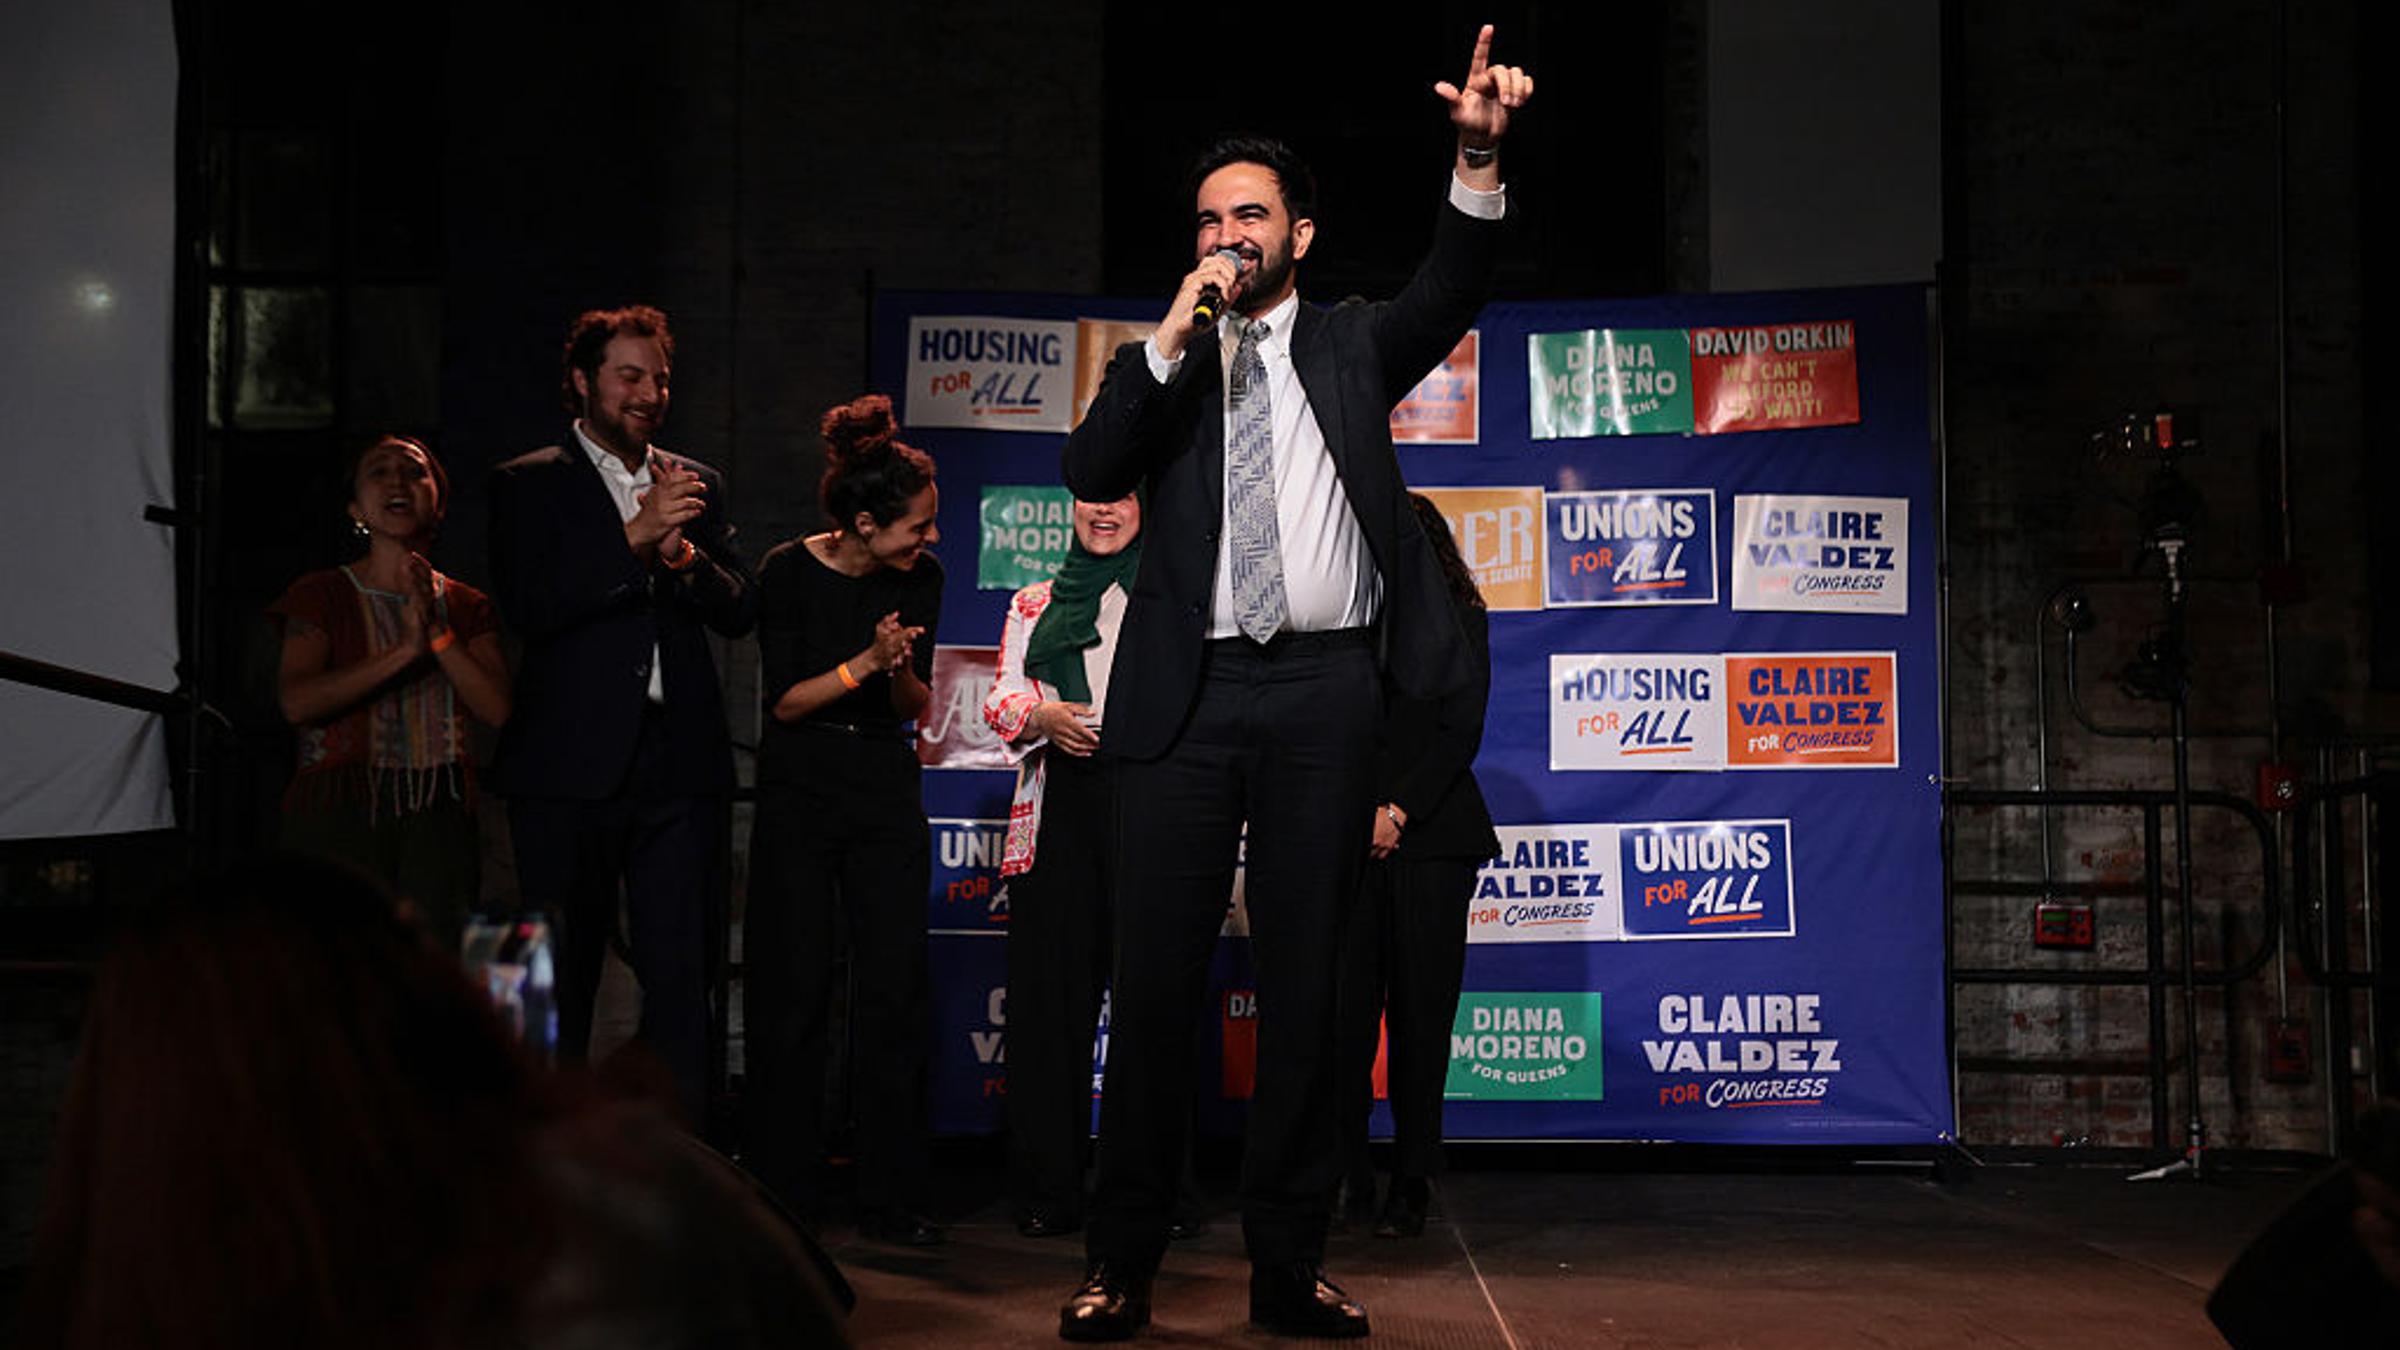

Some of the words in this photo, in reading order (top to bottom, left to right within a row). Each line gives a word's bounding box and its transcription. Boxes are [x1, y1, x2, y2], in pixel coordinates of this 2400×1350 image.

[919, 329, 1061, 365] HOUSING
[1695, 330, 1769, 355] DAVID
[1775, 323, 1850, 351] ORKIN
[1567, 345, 1656, 370] DIANA
[1722, 361, 1752, 381] WE
[1761, 359, 1817, 380] CAN'T
[932, 370, 972, 396] FOR
[970, 371, 1043, 405] ALL
[1547, 370, 1677, 397] MORENO
[1738, 380, 1813, 401] AFFORD
[1764, 399, 1823, 419] WAIT!
[1561, 501, 1695, 541] UNIONS
[1764, 509, 1882, 540] CLAIRE
[1447, 506, 1534, 569] ER
[1013, 554, 1042, 571] FOR
[1570, 547, 1614, 576] FOR
[1612, 542, 1687, 583] ALL
[1749, 544, 1894, 571] VALDEZ
[1794, 572, 1885, 595] CONGRESS
[1563, 668, 1711, 701] HOUSING
[1749, 667, 1870, 696] CLAIRE
[1577, 711, 1620, 737] FOR
[1619, 708, 1693, 746] ALL
[1737, 701, 1885, 726] VALDEZ
[1748, 734, 1780, 753] FOR
[1783, 729, 1876, 752] CONGRESS
[941, 831, 1004, 868] UNI
[1478, 840, 1590, 869] LAIRE
[1634, 832, 1771, 872] UNIONS
[947, 876, 990, 903] FOR
[1477, 874, 1604, 899] ALDEZ
[1644, 879, 1688, 907] FOR
[1687, 874, 1763, 916] ALL
[1471, 908, 1500, 926] FOR
[1504, 902, 1595, 926] CONGRESS
[1473, 1007, 1565, 1032] DIANA
[1658, 994, 1821, 1033] CLAIRE
[1450, 1034, 1587, 1060] MORENO
[1642, 1040, 1842, 1072] VALDEZ
[1472, 1063, 1502, 1082] FOR
[1506, 1064, 1567, 1084] QUEENS
[1659, 1084, 1700, 1105] FOR
[1705, 1078, 1829, 1108] CONGRESS
